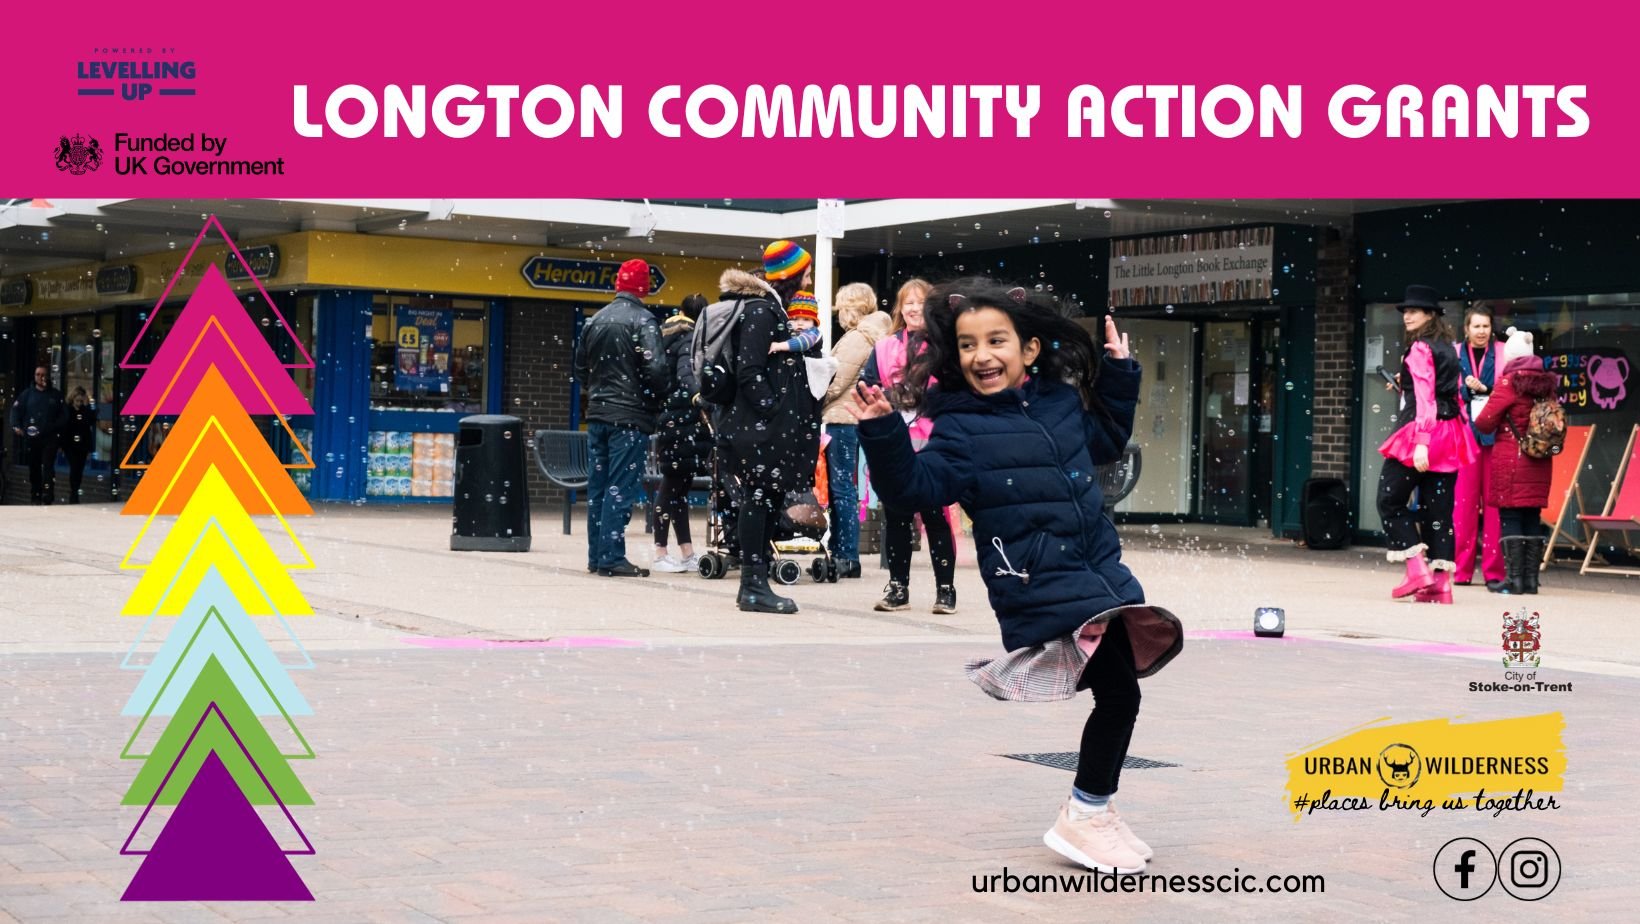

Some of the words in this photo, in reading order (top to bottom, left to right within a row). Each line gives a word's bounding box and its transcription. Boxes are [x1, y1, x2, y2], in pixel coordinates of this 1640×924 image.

[533, 261, 596, 284] Heron
[1114, 265, 1130, 279] The
[1132, 263, 1154, 278] Little
[1157, 261, 1194, 279] Longton
[1197, 258, 1221, 273] Book
[1223, 254, 1268, 272] Exchange
[402, 333, 416, 344] £5
